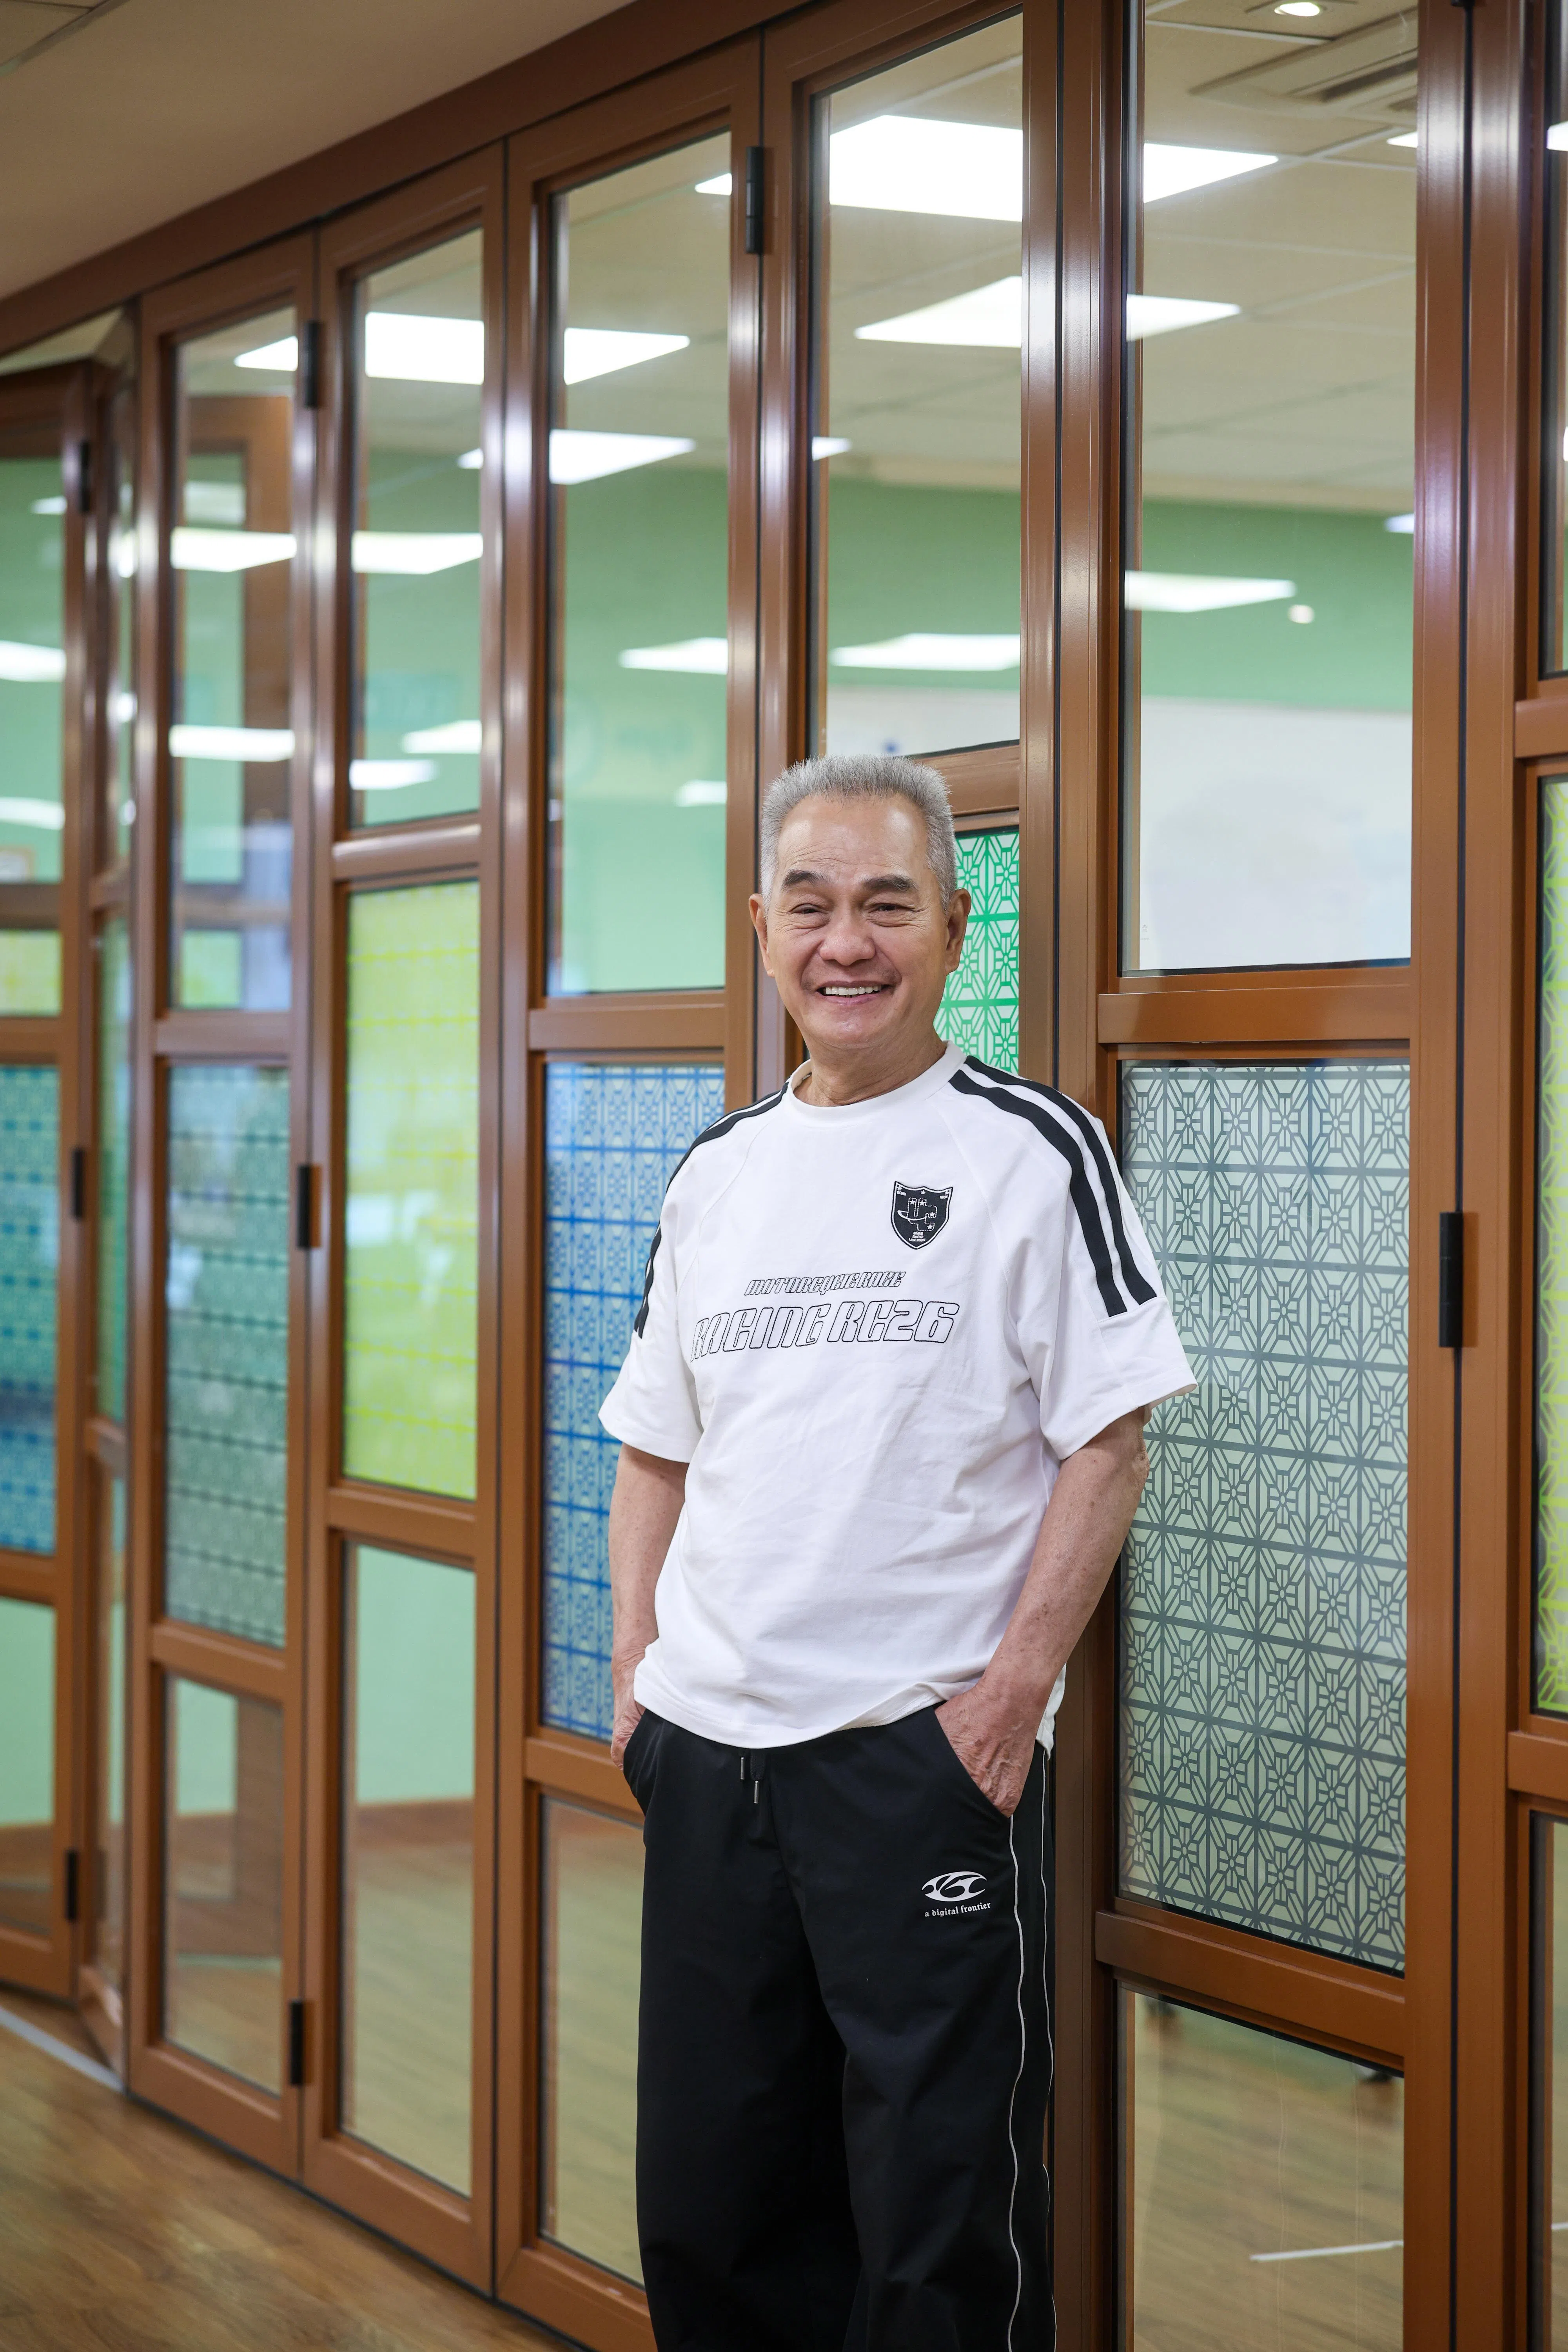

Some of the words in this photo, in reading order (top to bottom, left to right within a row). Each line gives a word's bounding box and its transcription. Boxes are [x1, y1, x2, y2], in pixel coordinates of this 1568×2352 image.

[690, 1303, 831, 1363] RACING
[827, 1299, 960, 1343] RC26
[932, 1906, 959, 1917] digital
[961, 1902, 991, 1913] frontier
